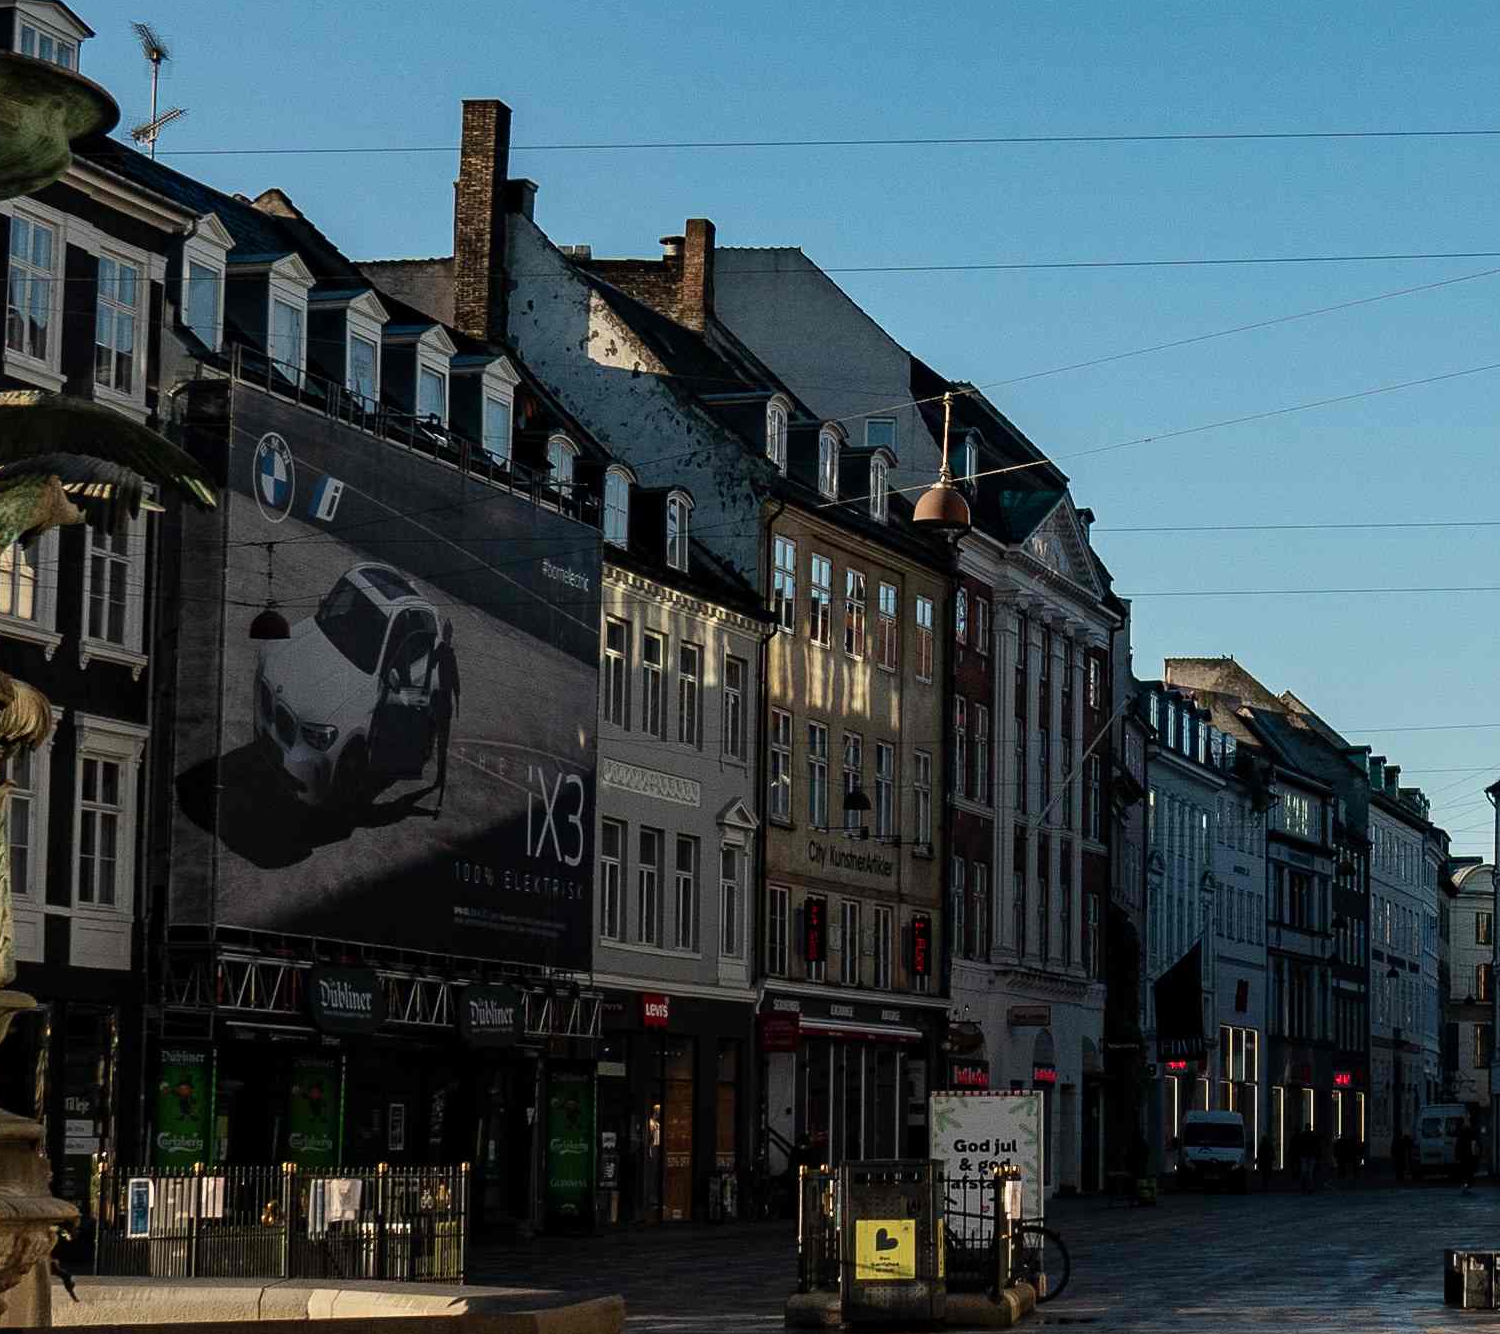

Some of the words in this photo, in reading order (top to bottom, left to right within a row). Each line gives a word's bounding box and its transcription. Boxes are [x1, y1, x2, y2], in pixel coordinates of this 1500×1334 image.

[525, 764, 584, 867] iX3
[156, 1131, 204, 1153] Carlsberg
[954, 1139, 990, 1153] God
[994, 1139, 1017, 1156] jul
[959, 1158, 972, 1171] &
